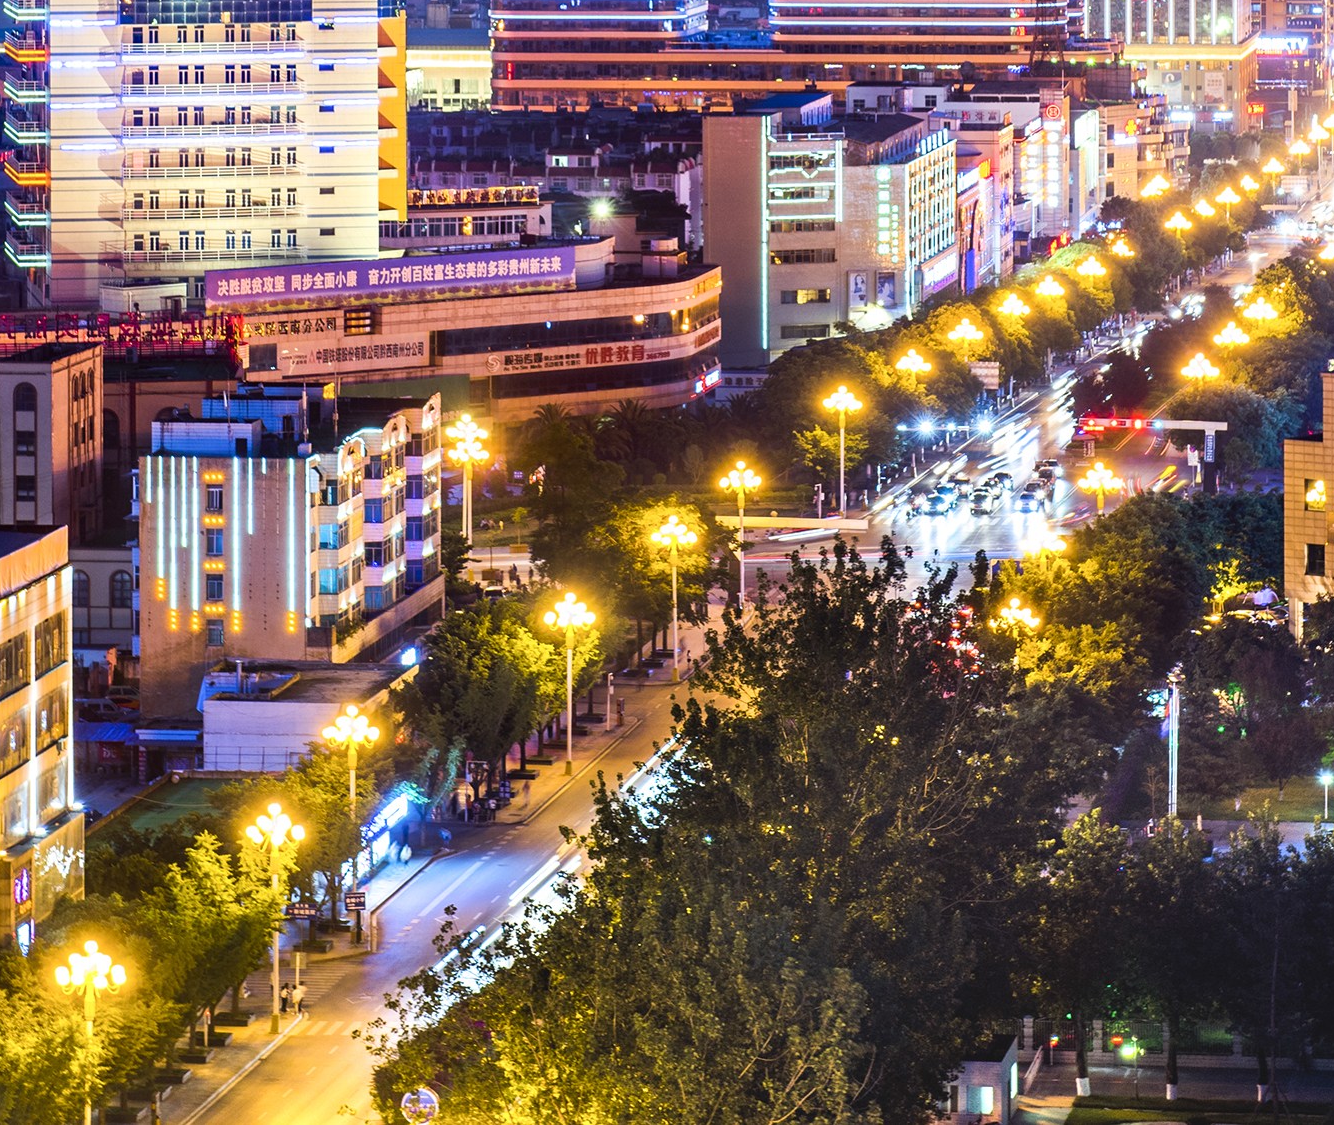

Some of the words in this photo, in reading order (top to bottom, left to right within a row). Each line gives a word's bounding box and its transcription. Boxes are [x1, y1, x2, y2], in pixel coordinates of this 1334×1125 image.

[217, 275, 286, 296] 决胜脱贫攻坚
[291, 270, 357, 292] 同步全面小康
[368, 255, 562, 286] 奋力开创百姓富生态美的多彩贵州新未来
[316, 341, 424, 364] 中国铁塔股份有限公司黔西南州分公司
[585, 344, 645, 365] 优胜教育
